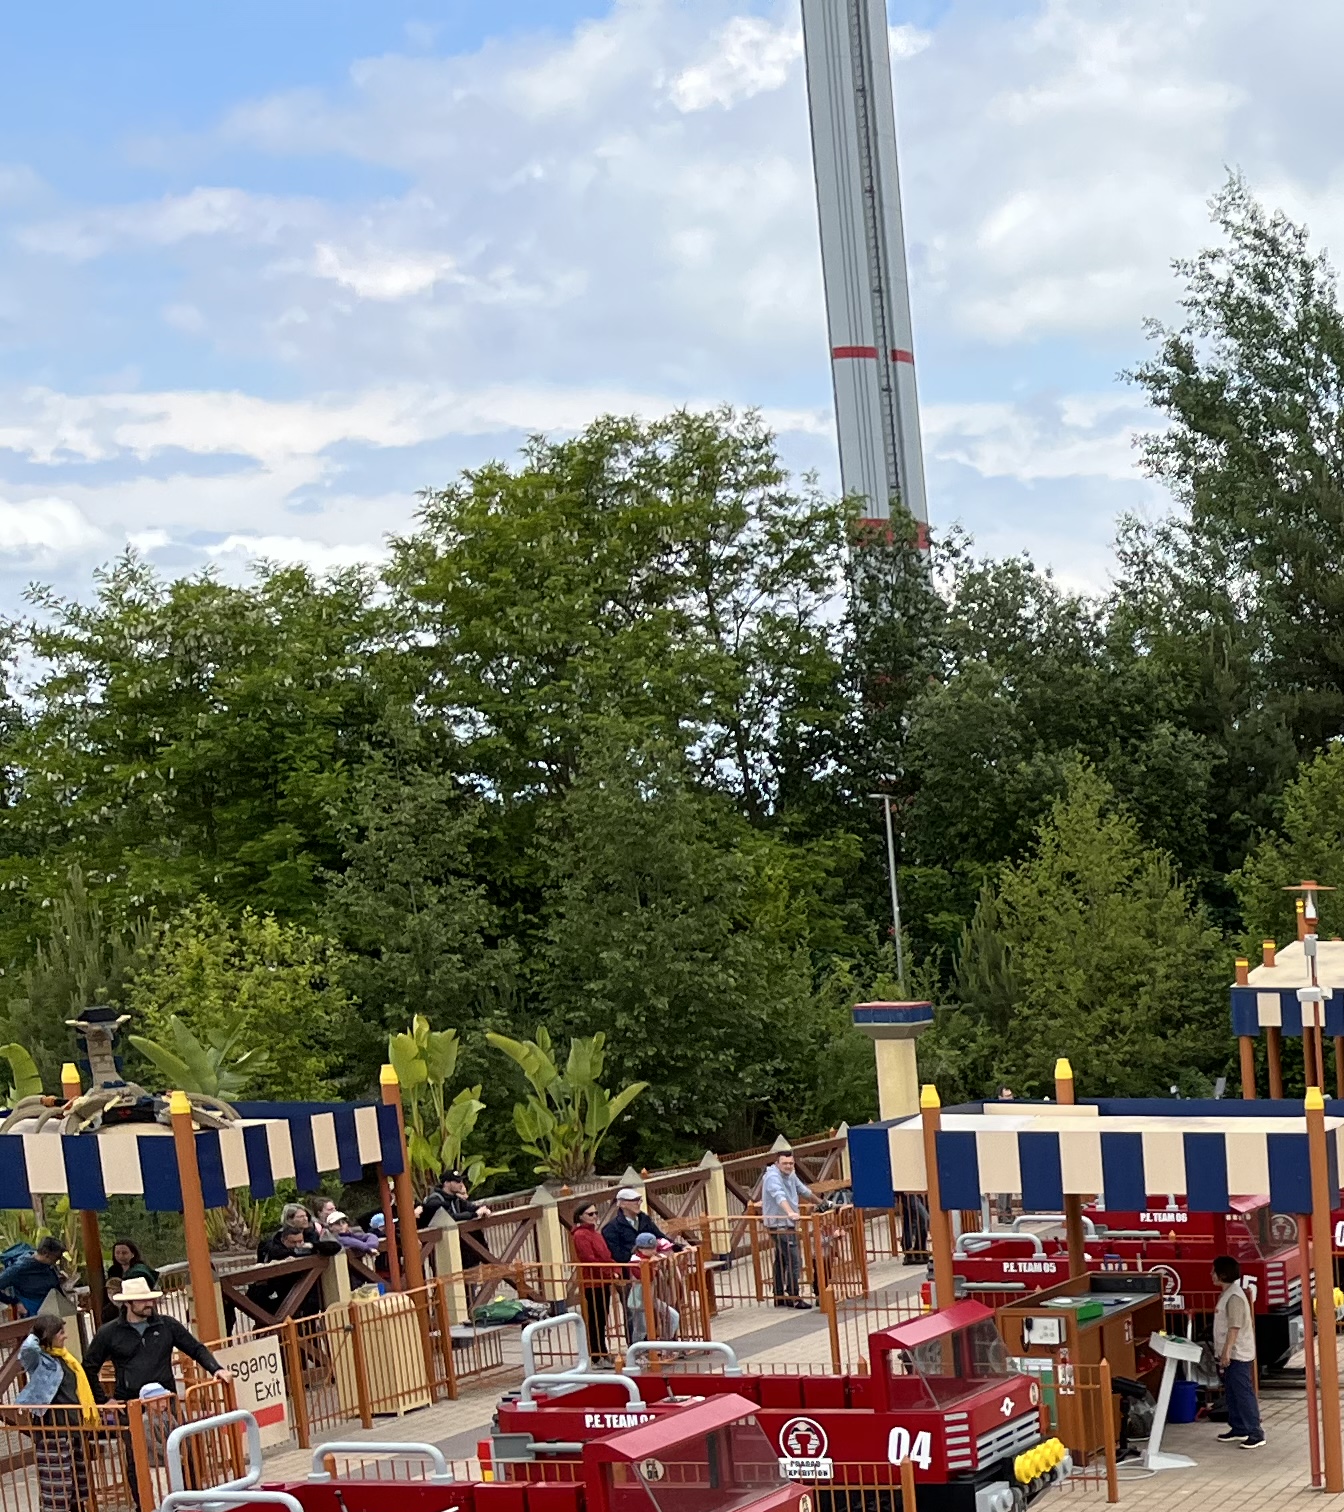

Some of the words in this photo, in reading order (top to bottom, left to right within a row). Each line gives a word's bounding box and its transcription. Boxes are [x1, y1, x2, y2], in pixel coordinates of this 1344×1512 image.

[1153, 1212, 1175, 1222] TEAM
[1017, 1262, 1042, 1272] TEAM
[1043, 1262, 1056, 1273] 05
[1242, 1274, 1258, 1303] 5
[227, 1353, 279, 1381] sgang
[255, 1378, 282, 1402] Exit
[584, 1414, 604, 1428] P.E.
[604, 1414, 638, 1428] TEAM
[888, 1427, 932, 1470] 04
